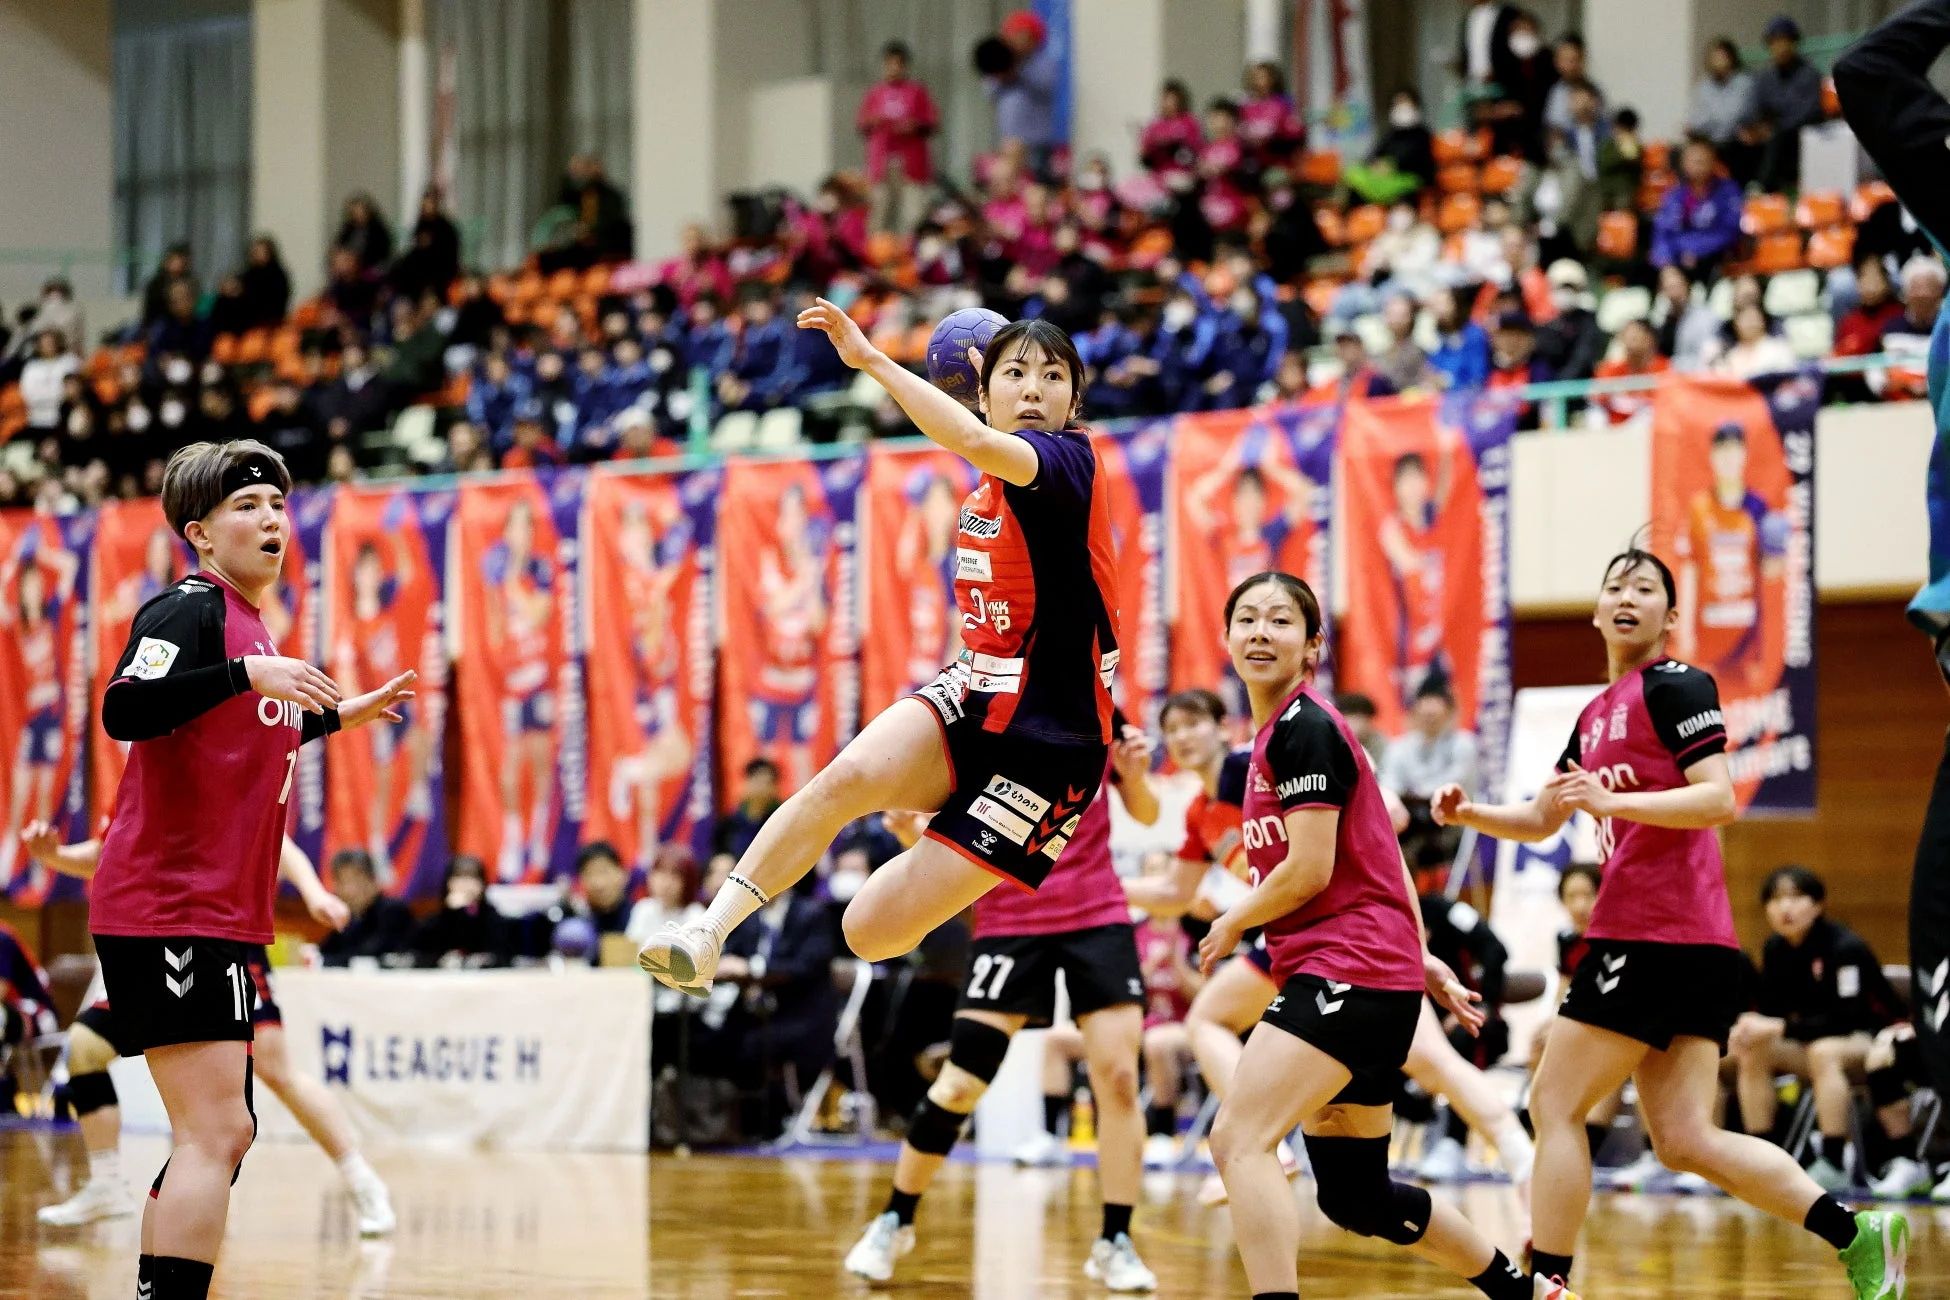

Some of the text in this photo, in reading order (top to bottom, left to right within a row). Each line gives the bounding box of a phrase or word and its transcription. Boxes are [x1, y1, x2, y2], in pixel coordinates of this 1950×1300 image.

[1011, 790, 1039, 812] もりのわ
[972, 840, 993, 855] hummel
[966, 953, 1015, 1000] 27
[365, 1034, 542, 1084] LEAGUE H
